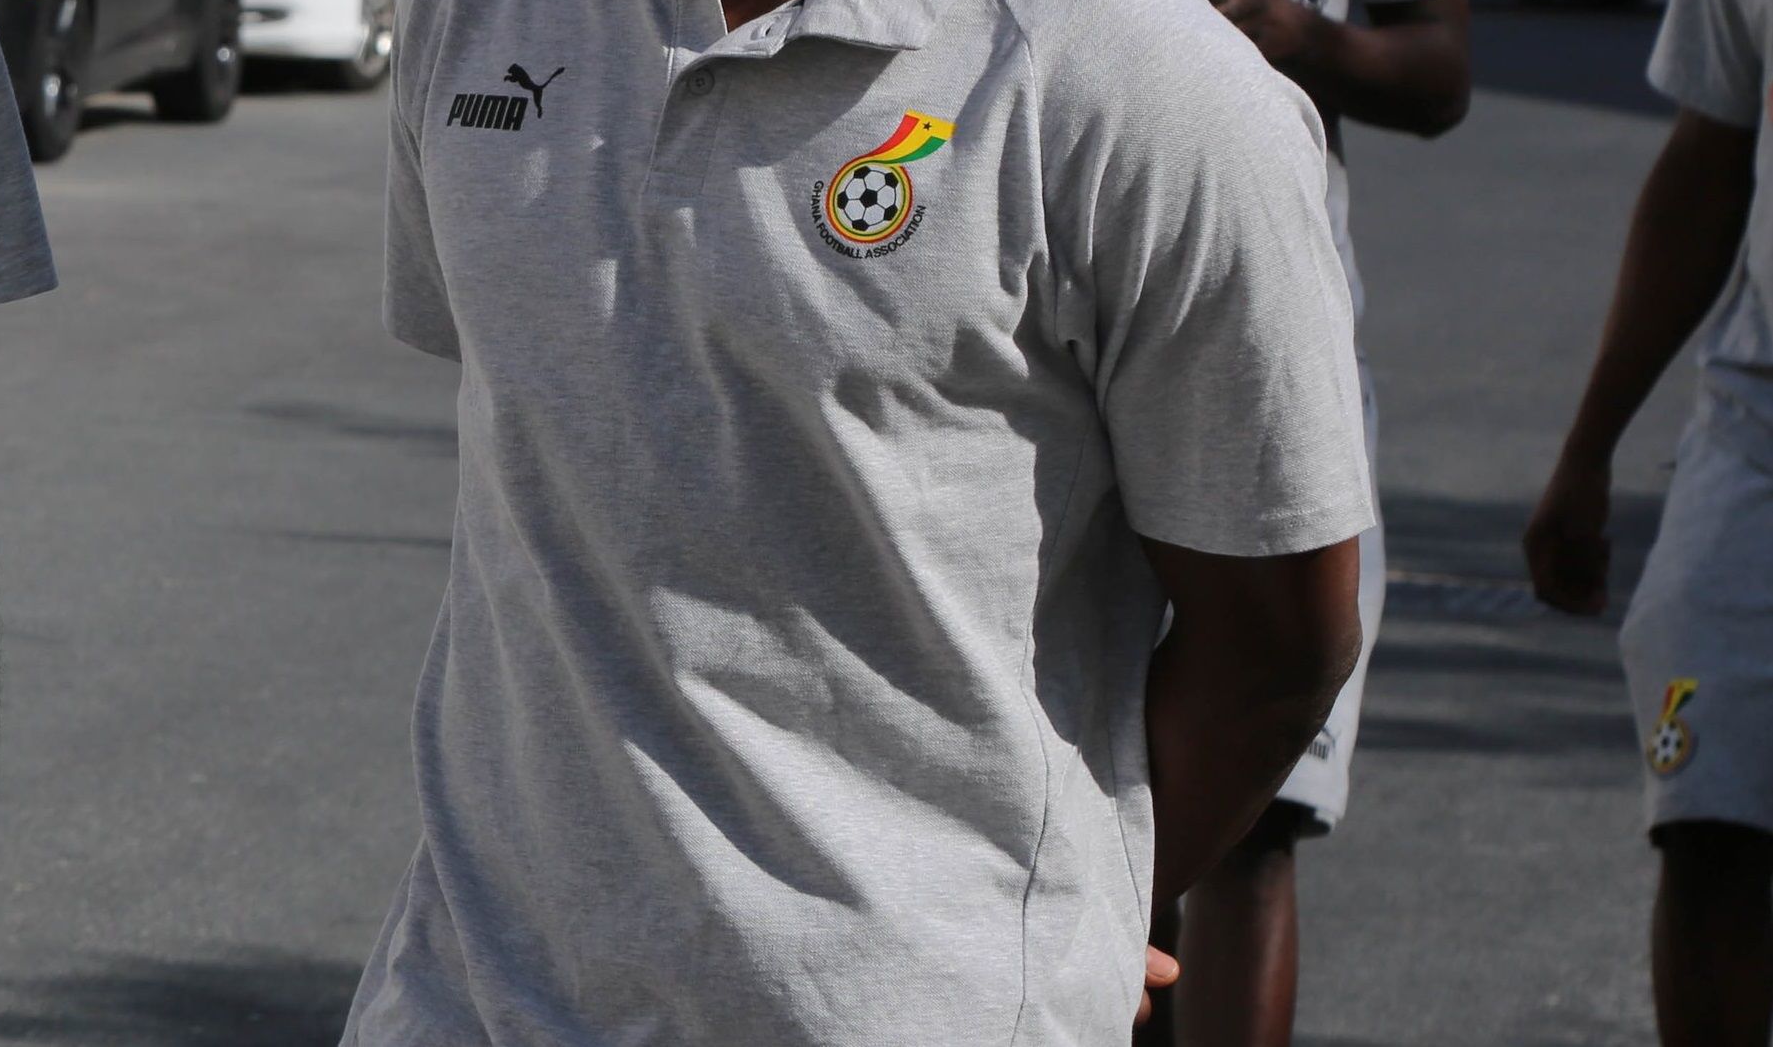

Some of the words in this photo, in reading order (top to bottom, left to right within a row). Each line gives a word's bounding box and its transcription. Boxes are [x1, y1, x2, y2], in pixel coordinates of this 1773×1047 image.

[446, 93, 529, 131] PUMA
[811, 180, 825, 224] GHANA
[816, 222, 862, 260] FOOTBALL
[864, 204, 927, 259] ASSOCIATION
